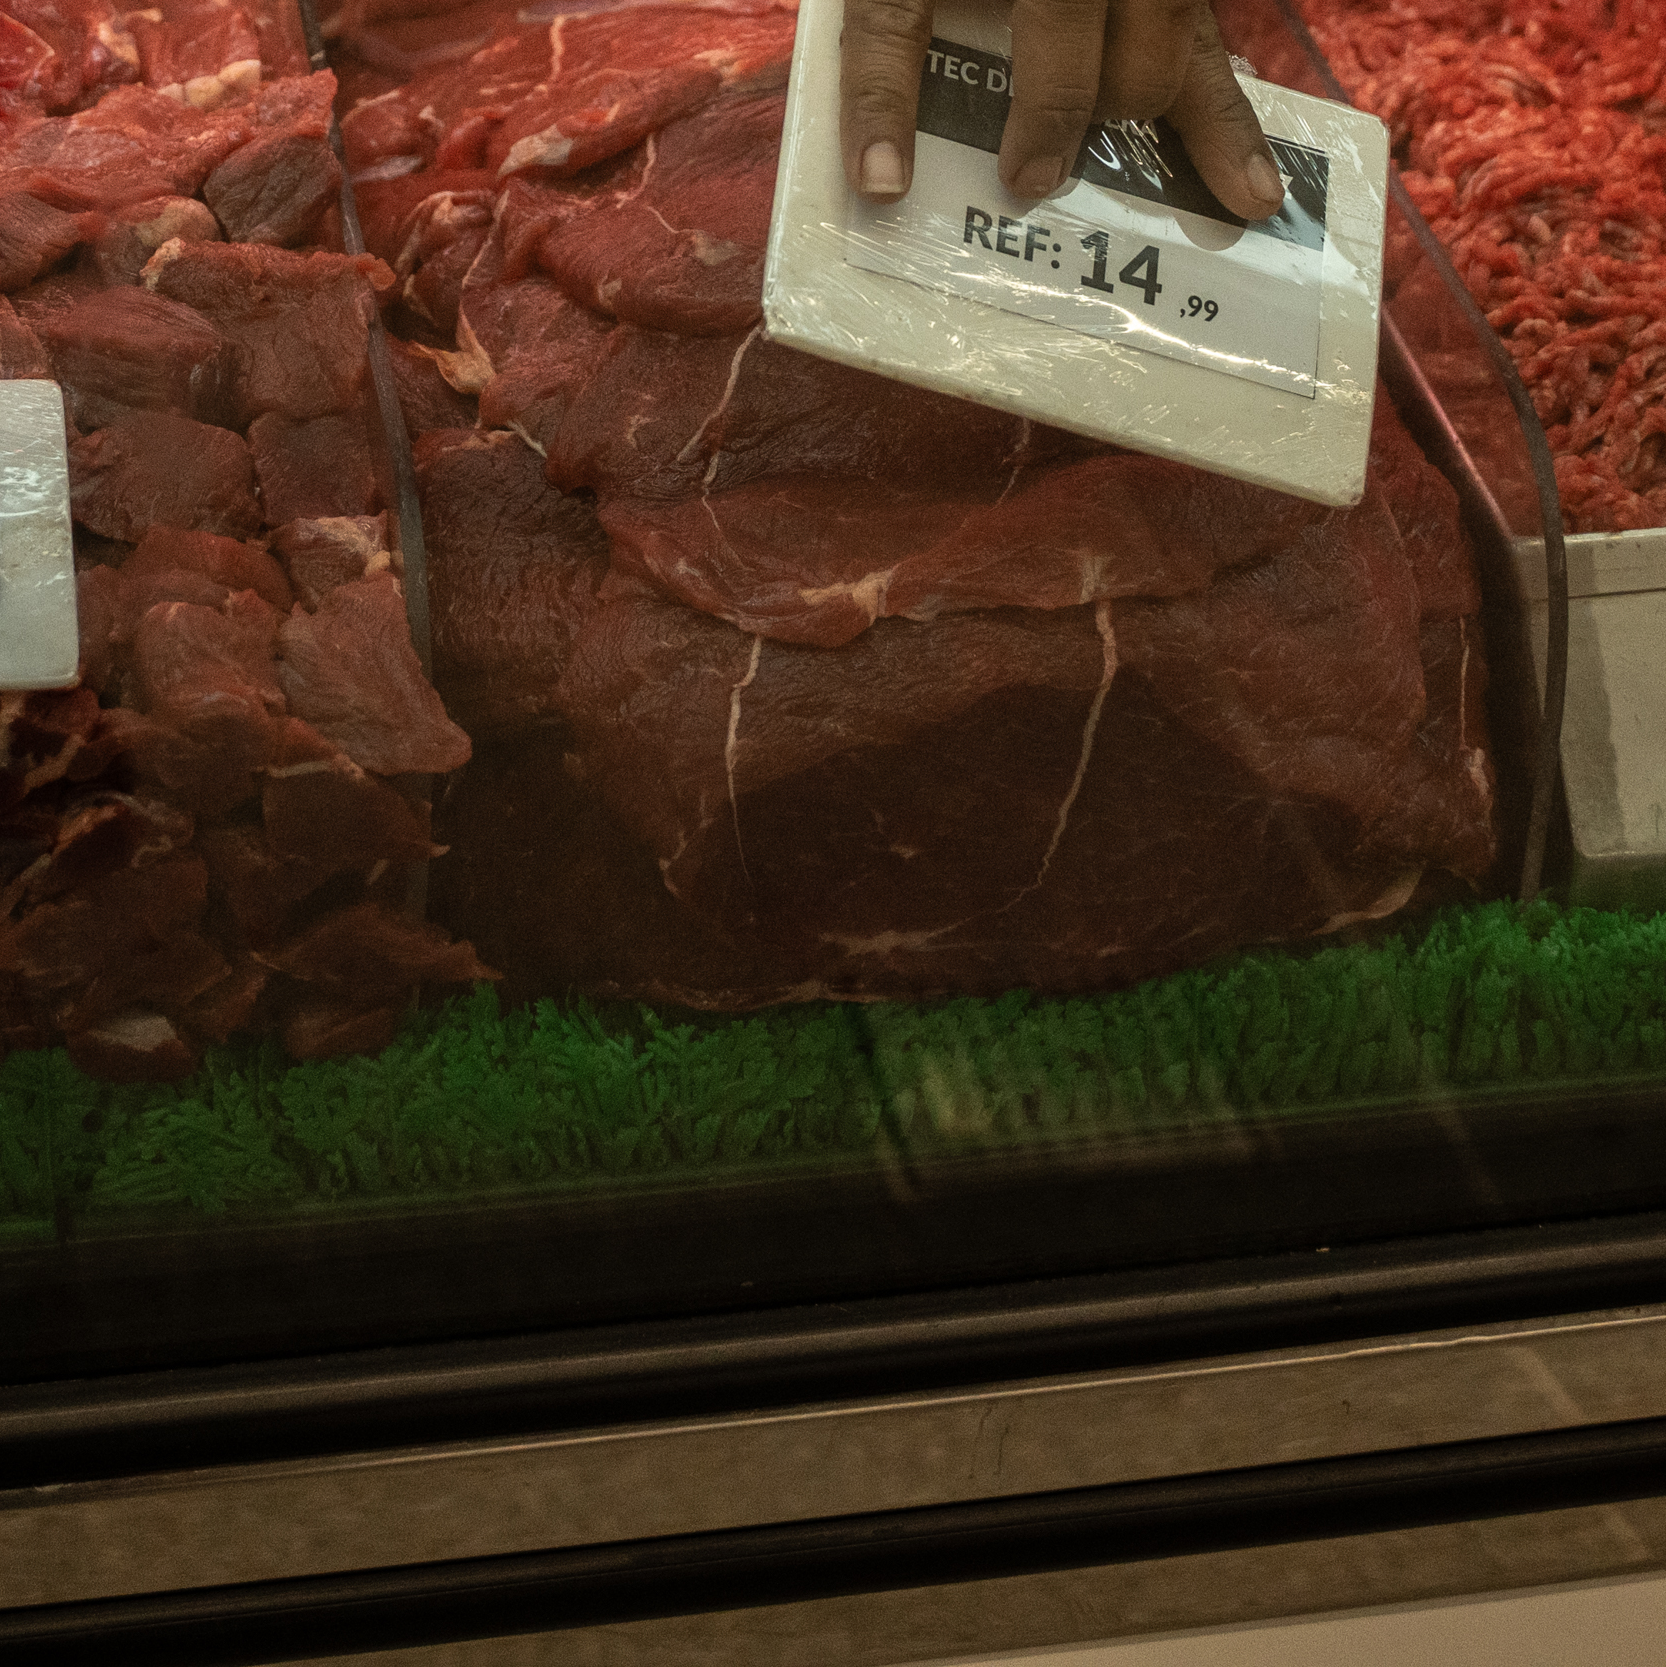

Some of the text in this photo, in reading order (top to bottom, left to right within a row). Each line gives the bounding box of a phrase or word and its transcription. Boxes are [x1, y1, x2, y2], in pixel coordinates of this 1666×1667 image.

[985, 67, 1015, 97] D
[963, 205, 1219, 322] REF: 14 ,99
